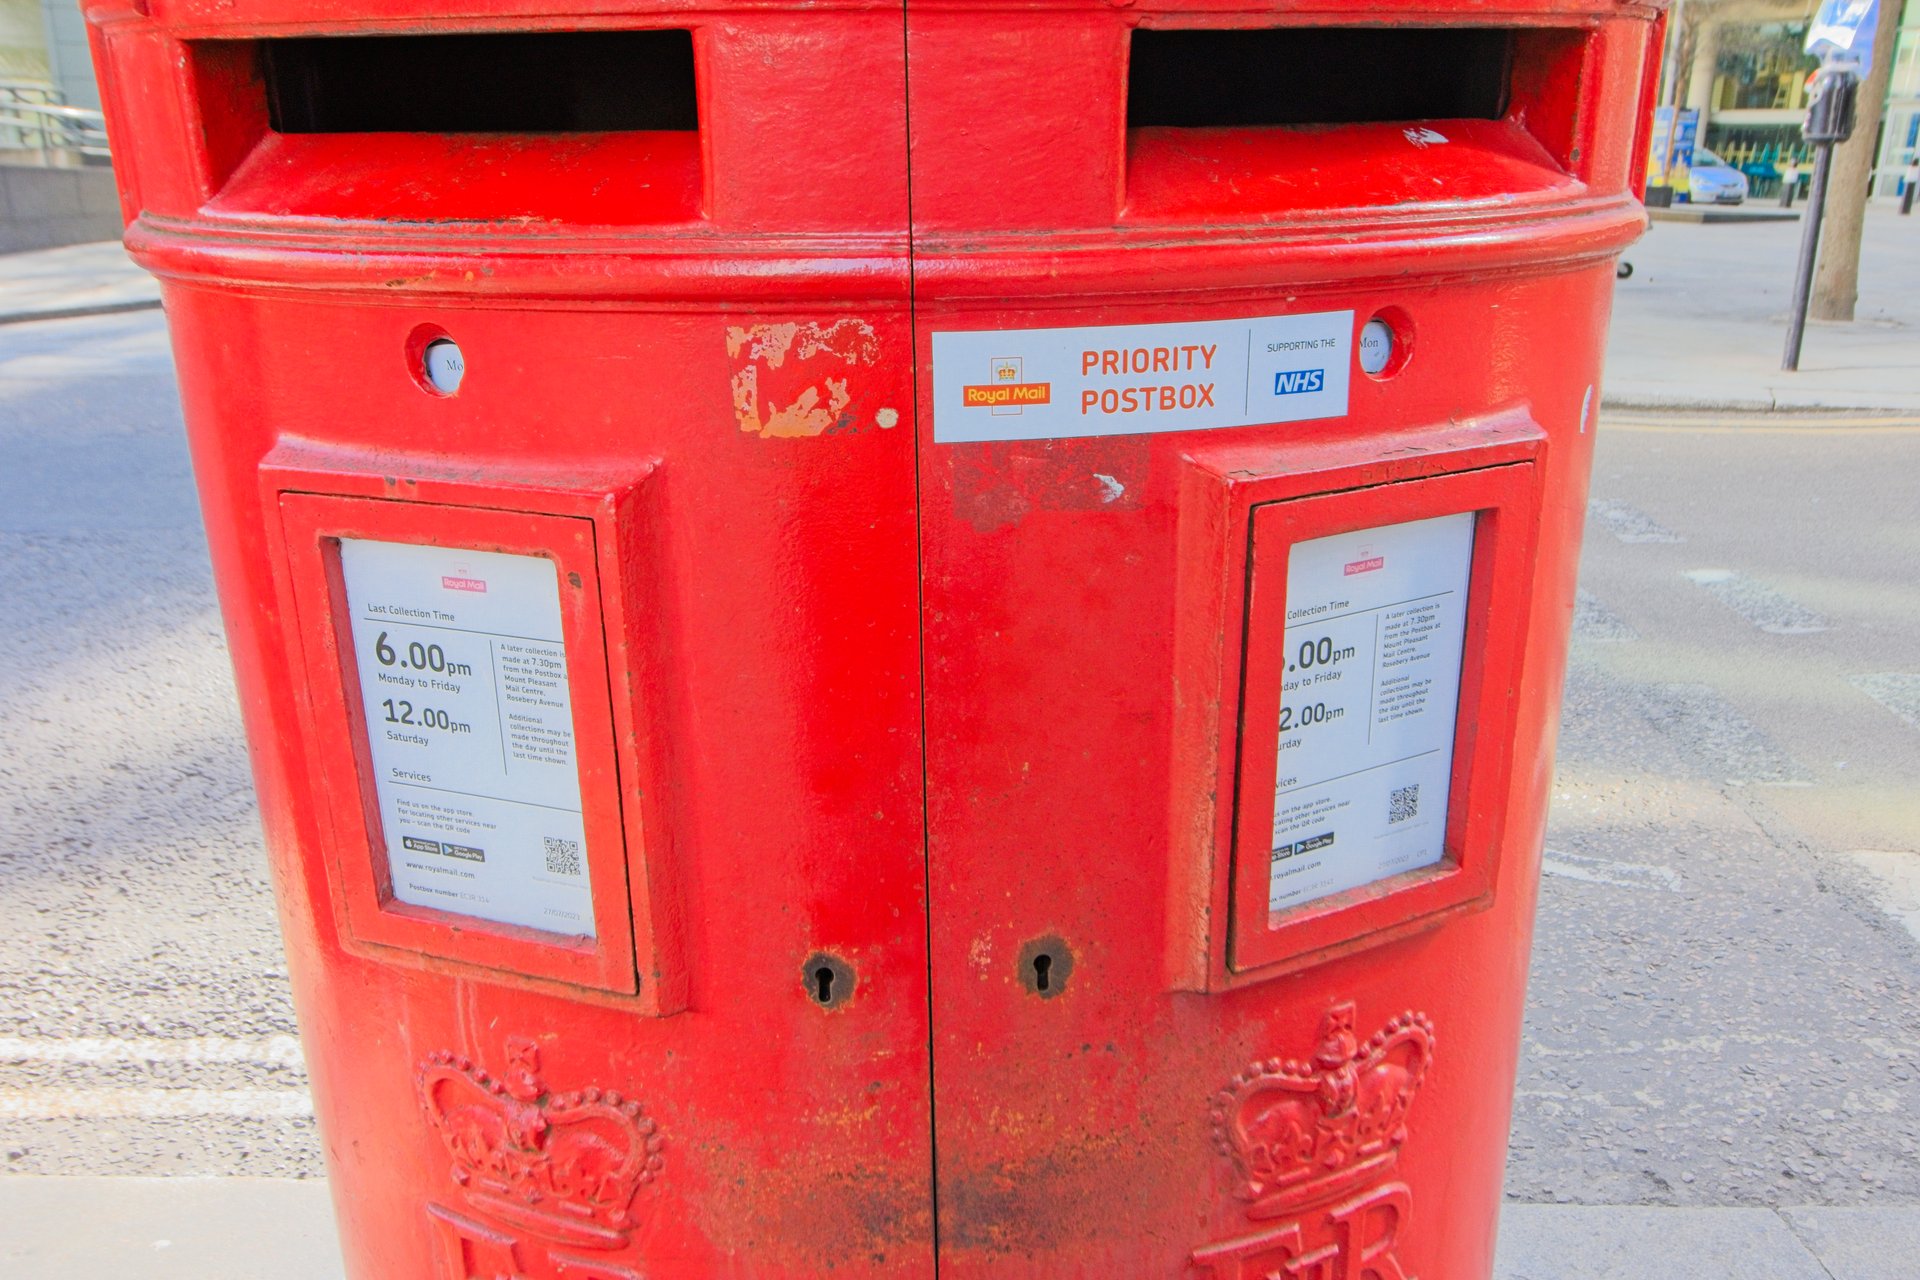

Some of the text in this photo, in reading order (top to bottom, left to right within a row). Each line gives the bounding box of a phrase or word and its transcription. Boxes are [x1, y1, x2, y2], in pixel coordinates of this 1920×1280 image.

[1267, 338, 1336, 353] SUPPORTING THE
[1082, 344, 1217, 376] PRIORITY
[1276, 370, 1322, 394] NHS
[968, 385, 1046, 404] Royal Mail
[1082, 383, 1215, 415] POSTBOX
[1346, 558, 1383, 573] Royal Mail
[444, 578, 485, 590] Royal Mail
[367, 603, 455, 621] Last Collection Time
[1287, 600, 1350, 620] Collection Time
[1391, 611, 1405, 619] later
[1406, 605, 1434, 615] collection
[1385, 622, 1401, 631] made
[1410, 614, 1436, 625] 7.30pm
[1411, 625, 1433, 634] Postbox
[1384, 634, 1428, 649] Mount Pleasant
[376, 631, 472, 677] 6.00pm
[507, 644, 523, 653] later
[525, 647, 558, 657] collection
[1282, 636, 1355, 673] .00pm
[1383, 651, 1396, 659] Mail
[502, 656, 521, 664] made
[531, 657, 562, 669] 7.30pm
[1383, 653, 1431, 668] Rosebery Avenue
[503, 665, 520, 673] from
[521, 667, 533, 675] the
[535, 669, 562, 679] Postbox
[378, 672, 461, 694] Monday to Friday
[504, 675, 557, 688] Mount Pleasant
[1281, 670, 1342, 692] day to Friday
[1381, 674, 1410, 686] Additional
[505, 685, 520, 693] Mail
[1380, 685, 1410, 696] collections
[506, 694, 564, 708] Rosebery Avenue
[1379, 688, 1429, 705] made throughout
[1401, 700, 1415, 708] until
[382, 698, 471, 734] 12.00pm
[508, 713, 543, 724] Additional
[1390, 713, 1404, 721] time
[386, 730, 429, 746] Saturday
[509, 724, 545, 734] collections
[547, 729, 561, 738] may
[511, 733, 569, 747] made throughout
[525, 743, 536, 752] day
[512, 751, 525, 759] last
[527, 753, 542, 761] time
[392, 768, 432, 782] Services
[396, 798, 410, 806] Find
[443, 807, 455, 815] app
[1294, 811, 1311, 820] other
[1312, 805, 1336, 815] services
[1337, 800, 1351, 808] near
[397, 807, 408, 815] For
[409, 809, 434, 820] locating
[455, 818, 481, 827] services
[482, 822, 497, 830] near
[1311, 816, 1326, 824] code
[445, 823, 454, 831] QR
[456, 826, 471, 834] code
[405, 862, 476, 879] www.royalmail.com
[409, 883, 433, 893] Postbox
[434, 888, 458, 897] number
